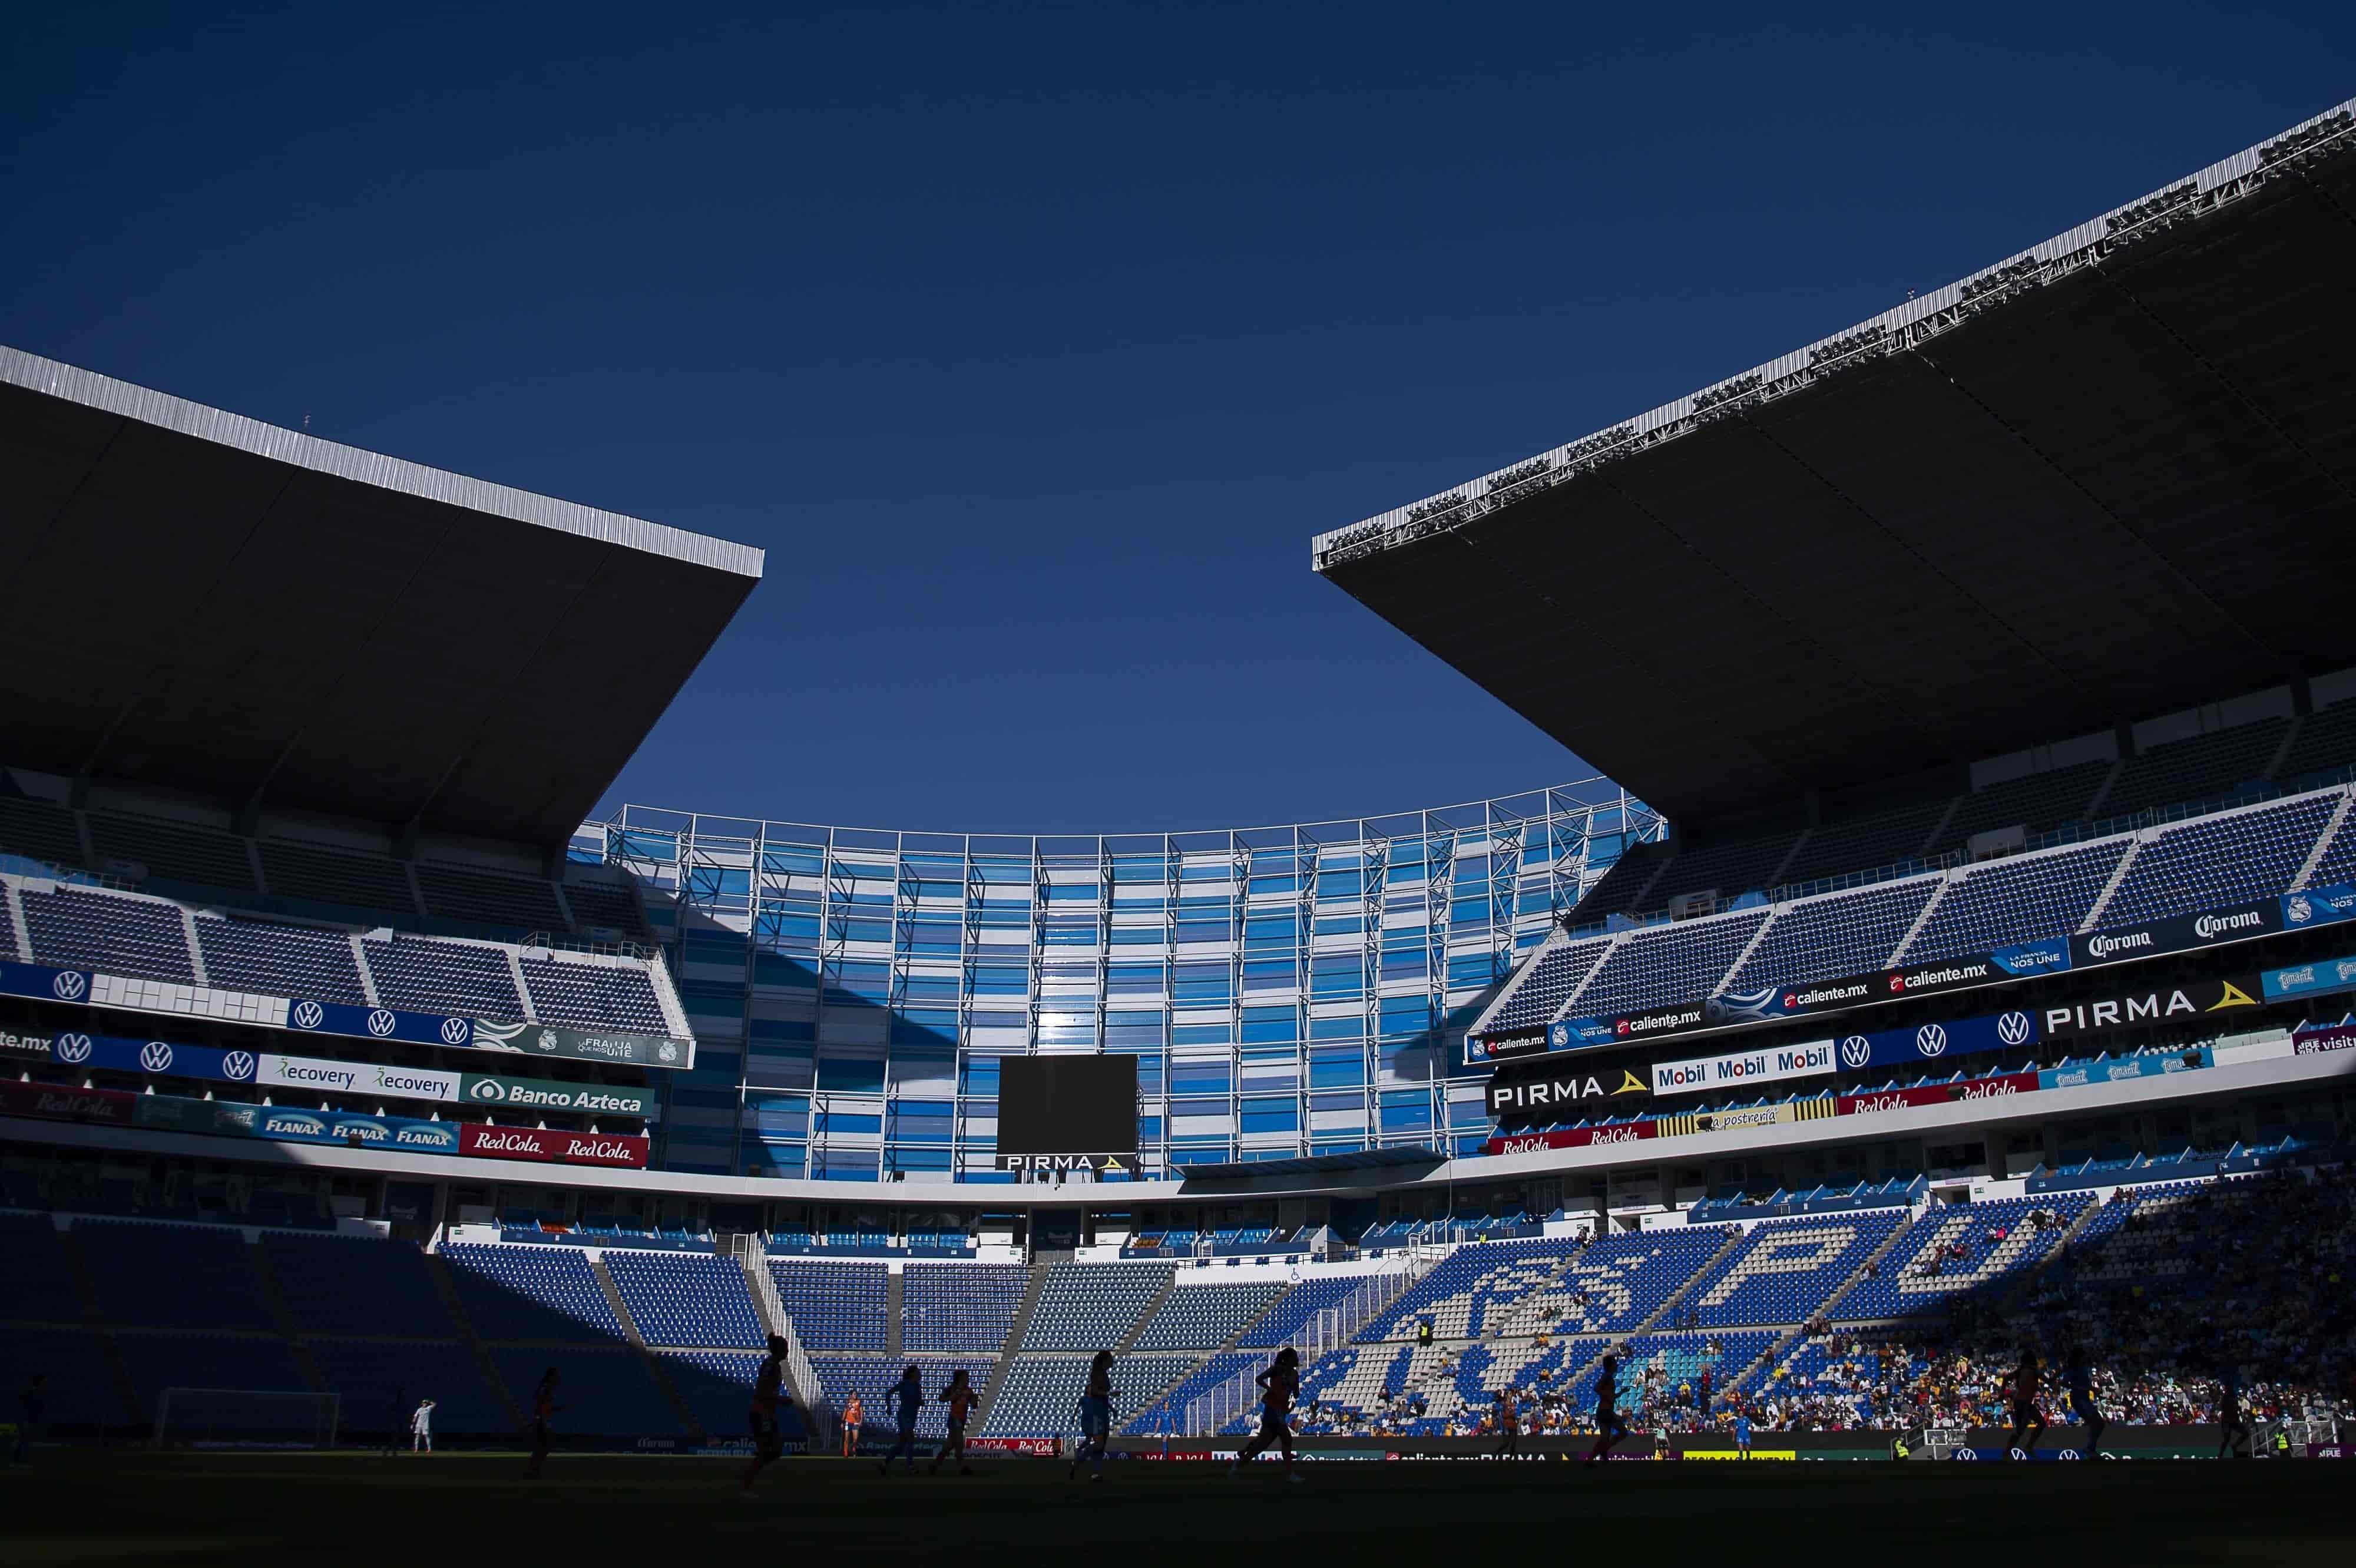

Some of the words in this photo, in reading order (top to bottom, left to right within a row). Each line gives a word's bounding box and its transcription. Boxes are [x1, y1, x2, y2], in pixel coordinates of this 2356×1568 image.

[2331, 899, 2354, 908] NOS
[2195, 910, 2261, 938] Corona
[2089, 931, 2152, 958] Corona
[2010, 958, 2034, 968] NOS
[2037, 953, 2060, 964] UNE
[1905, 964, 1987, 988] caliente.mx
[1797, 983, 1867, 1005] caliente.mx
[1630, 1010, 1700, 1033] caliente.mx
[2047, 990, 2196, 1033] PIRMA
[0, 1031, 52, 1051] te.mx
[1497, 1034, 1546, 1051] caliente.mx
[1658, 1066, 1706, 1087] Mobil
[1718, 1059, 1766, 1083] Mobil
[1778, 1047, 1829, 1071] Mobil
[509, 1085, 570, 1107] Banco
[573, 1091, 642, 1113] Azteca
[1494, 1077, 1604, 1109] PIRMA
[266, 1119, 322, 1136] FLANAX
[396, 1130, 449, 1146] FLANAX
[1007, 1156, 1093, 1170] PIRMA
